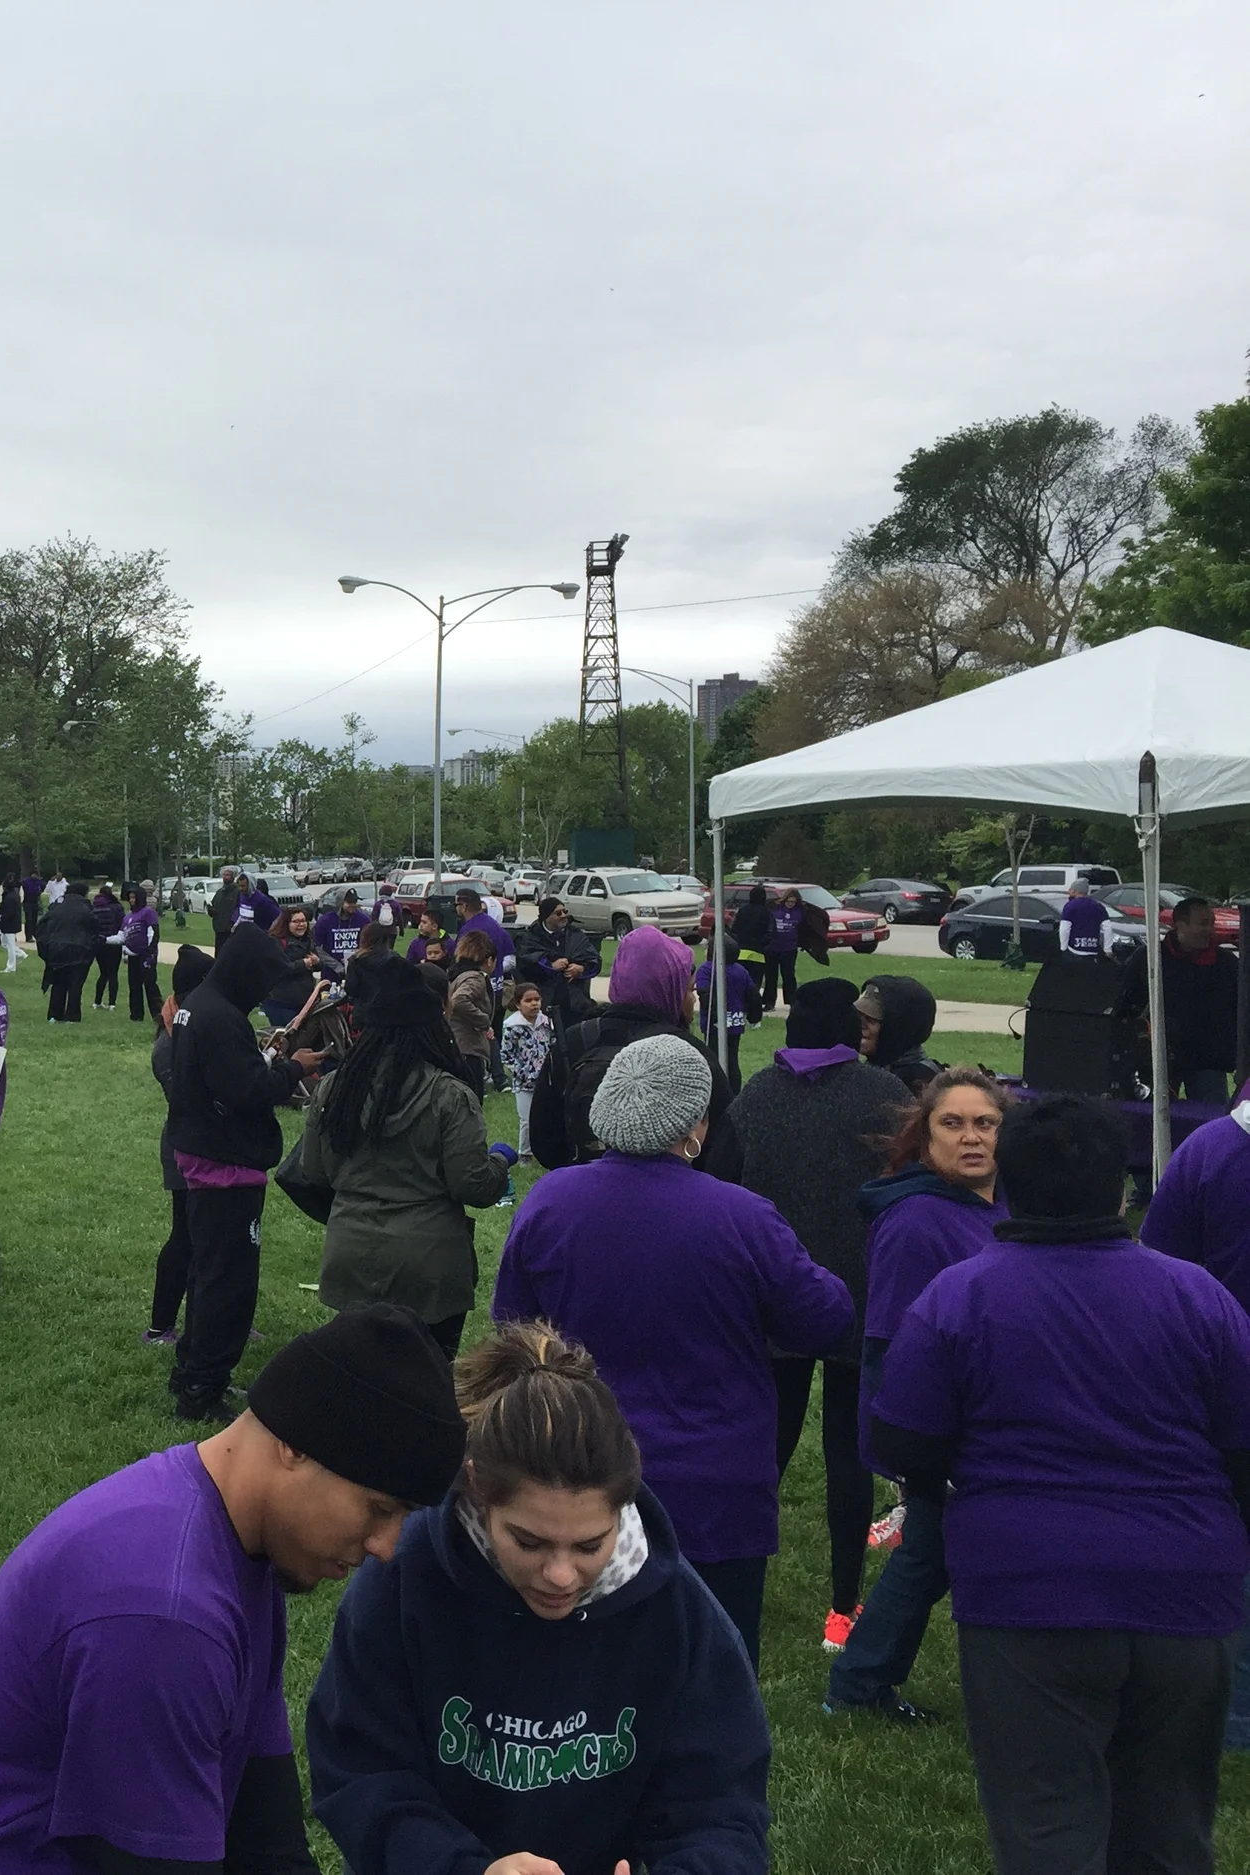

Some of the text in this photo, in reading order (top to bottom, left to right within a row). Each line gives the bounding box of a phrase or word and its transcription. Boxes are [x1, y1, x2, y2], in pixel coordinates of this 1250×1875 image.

[334, 932, 358, 941] KNOW
[334, 941, 358, 949] LUPUS
[486, 1710, 588, 1740] CHICAGO
